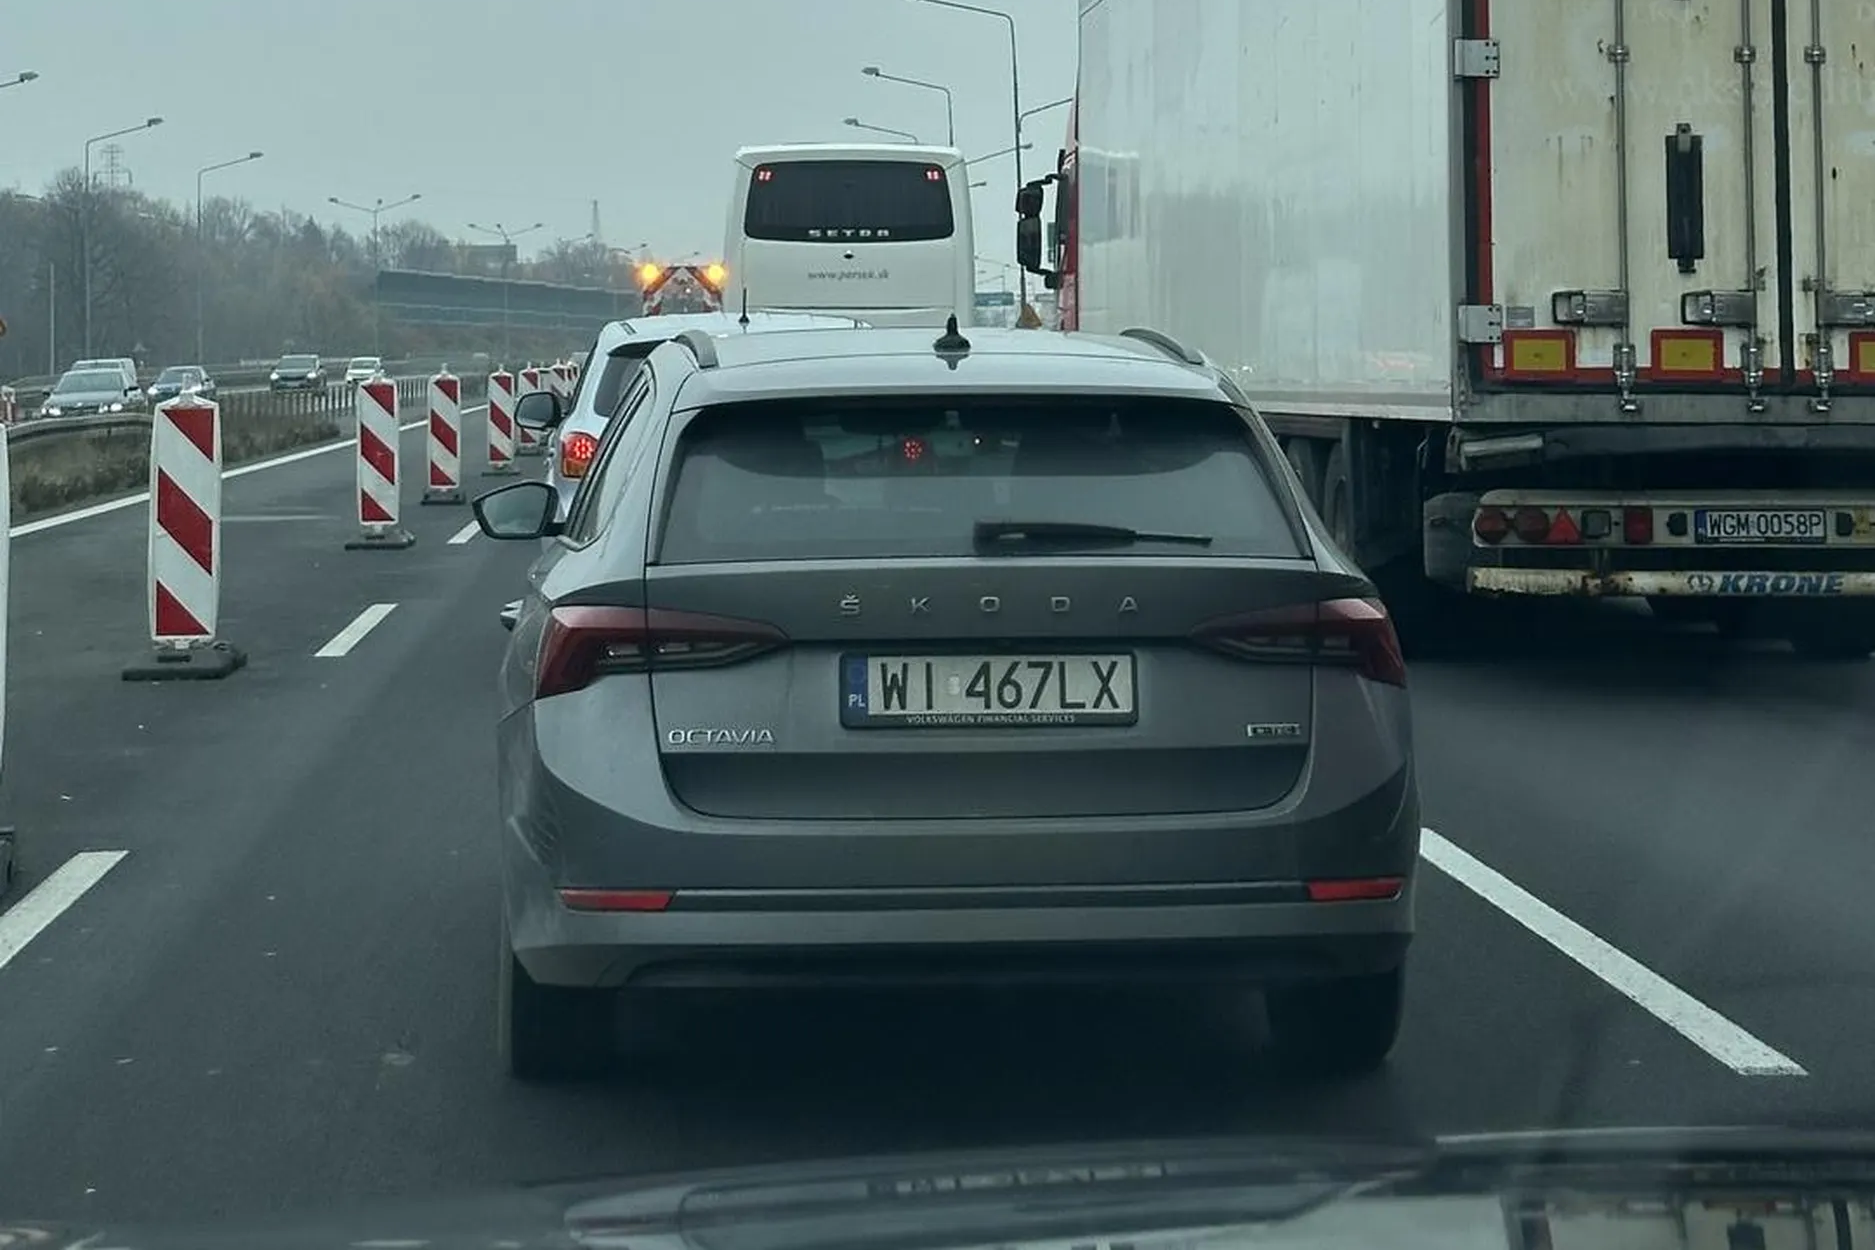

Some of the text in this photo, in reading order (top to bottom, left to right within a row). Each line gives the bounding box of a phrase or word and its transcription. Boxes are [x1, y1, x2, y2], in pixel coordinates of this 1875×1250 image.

[1708, 513, 1822, 536] WGM 0058P
[1718, 573, 1845, 595] KRONE
[839, 593, 1139, 616] ŠKODA
[879, 660, 1120, 711] WI 467LX
[848, 693, 866, 708] PL
[906, 713, 1075, 724] VOLKSWAGEN FINANCIAL SERVICES
[668, 729, 774, 744] OCTAVIA
